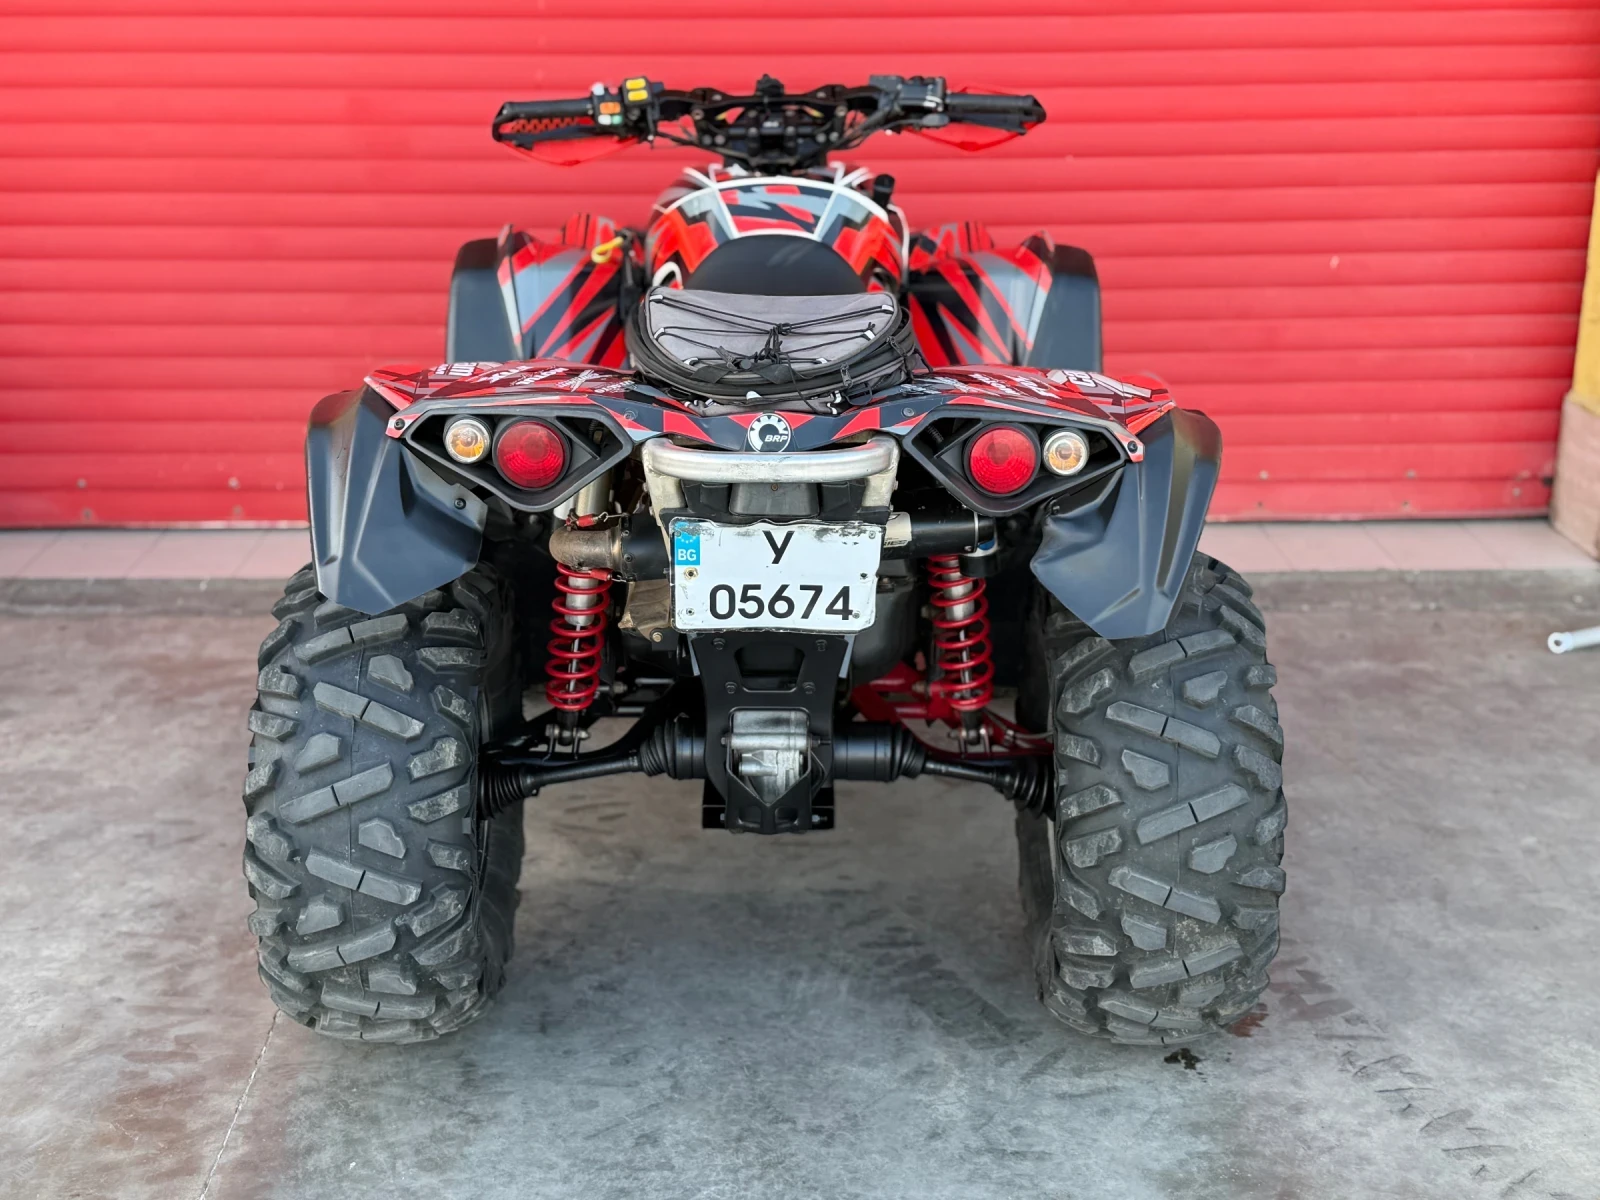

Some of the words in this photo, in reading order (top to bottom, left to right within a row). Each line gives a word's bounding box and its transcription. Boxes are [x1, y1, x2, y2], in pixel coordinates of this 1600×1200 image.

[764, 434, 788, 443] BRP
[677, 548, 697, 561] BG
[709, 584, 853, 621] 05674
